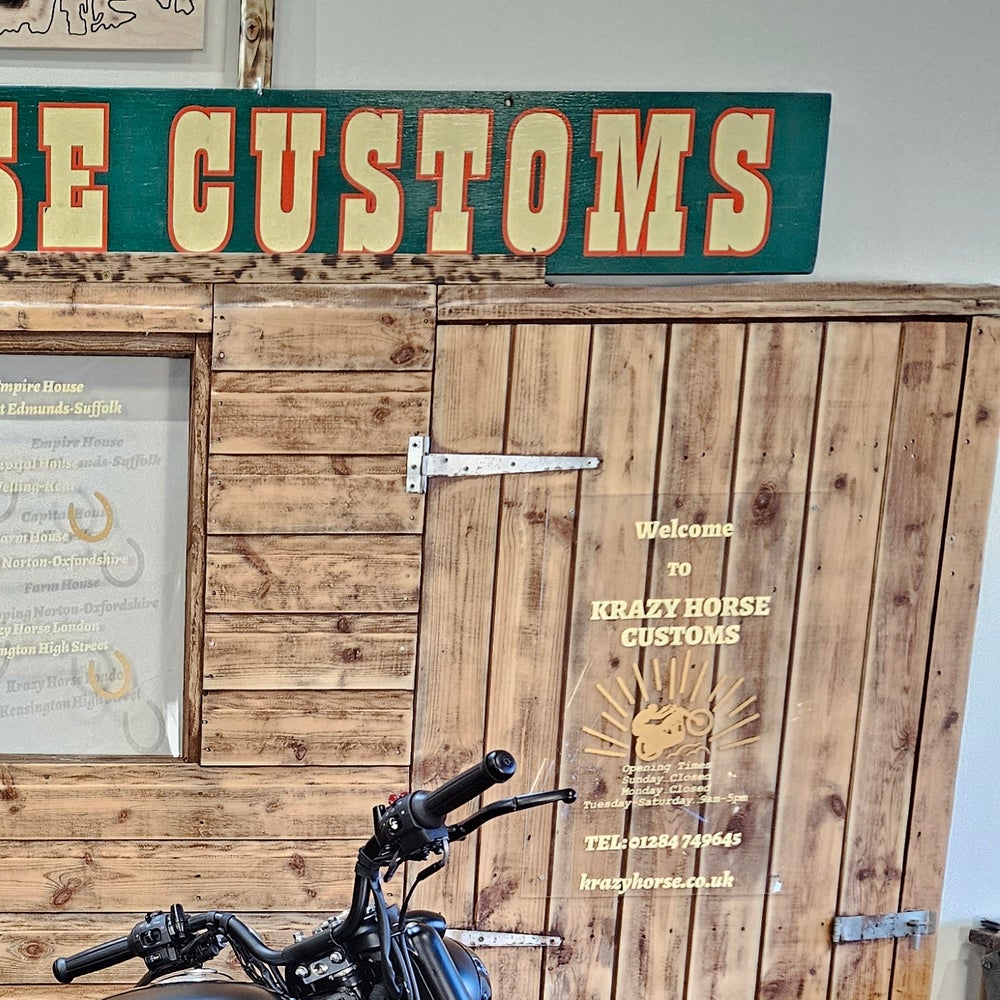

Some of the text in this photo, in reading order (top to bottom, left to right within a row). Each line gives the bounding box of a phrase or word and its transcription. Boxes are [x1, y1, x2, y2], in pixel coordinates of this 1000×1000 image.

[169, 105, 775, 256] CUSTOMS
[42, 380, 85, 393] House
[7, 399, 123, 419] Edmunds-Suffolk
[29, 531, 70, 545] House
[635, 518, 735, 540] Welcome
[3, 553, 129, 572] Norton-Oxfordshire
[666, 562, 692, 577] TO
[590, 596, 772, 621] KRAZY HORSE
[13, 624, 51, 637] Horse
[52, 622, 101, 635] London
[620, 624, 741, 648] CUSTOMS
[38, 641, 70, 657] High
[71, 639, 110, 652] Street
[622, 761, 713, 775] Opening Times
[682, 831, 743, 849] 749645
[579, 870, 735, 895] krazyhorse.co.uk
